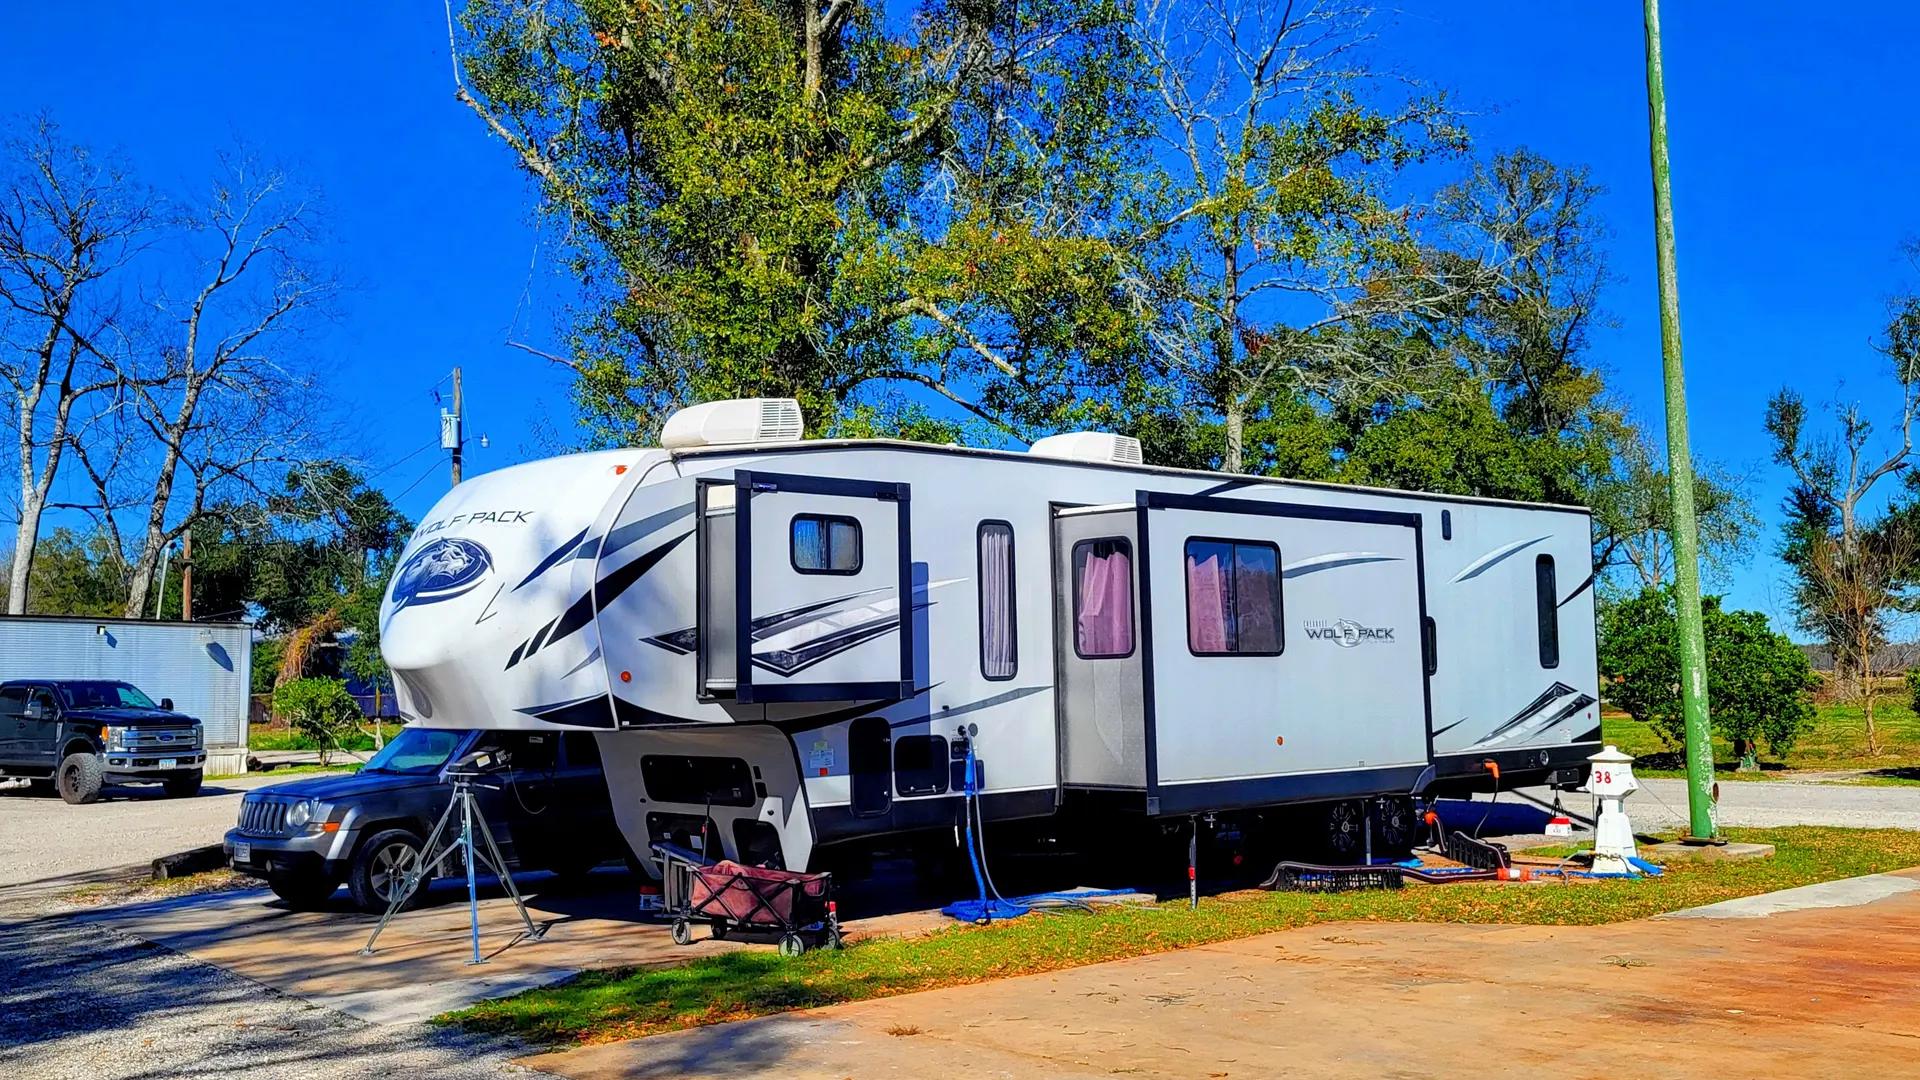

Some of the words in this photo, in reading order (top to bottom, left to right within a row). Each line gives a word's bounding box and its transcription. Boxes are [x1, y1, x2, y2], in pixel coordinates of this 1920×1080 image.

[413, 514, 466, 540] WOLF
[467, 510, 534, 524] PACK
[1304, 628, 1354, 640] WOLF
[1358, 628, 1395, 640] PACK
[1594, 770, 1612, 784] 38
